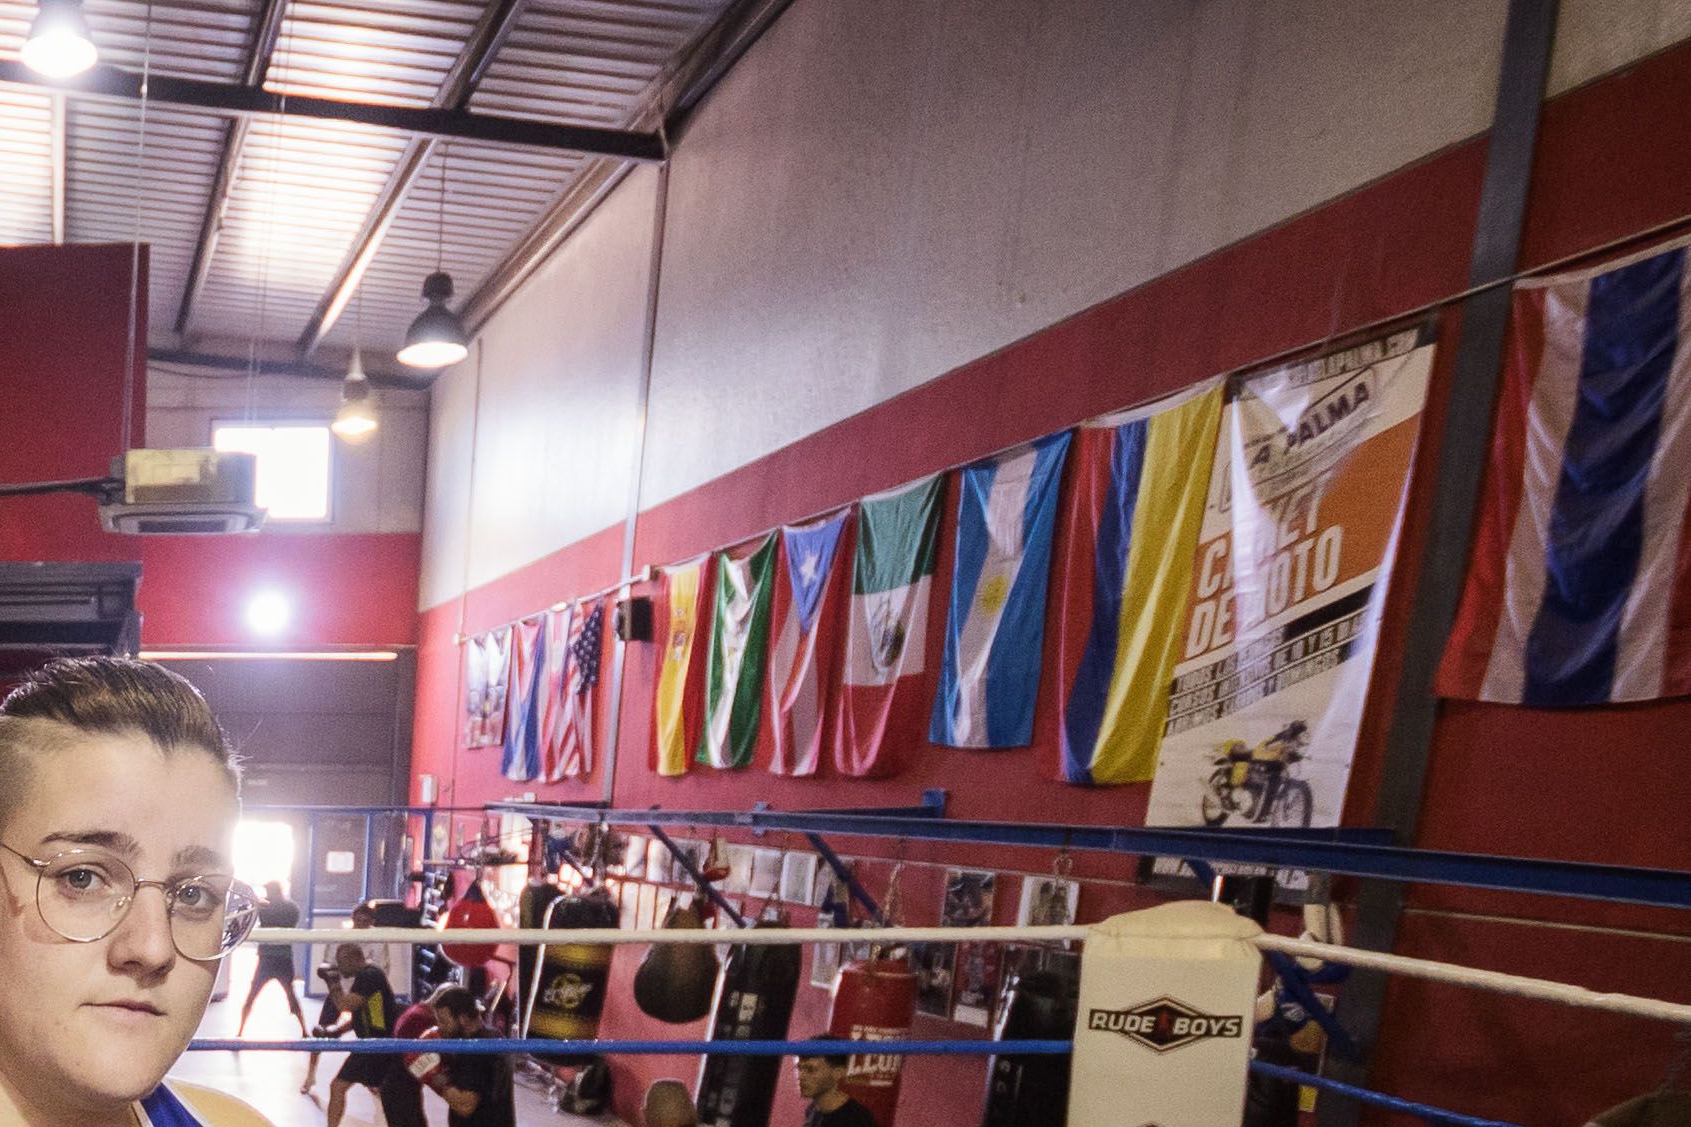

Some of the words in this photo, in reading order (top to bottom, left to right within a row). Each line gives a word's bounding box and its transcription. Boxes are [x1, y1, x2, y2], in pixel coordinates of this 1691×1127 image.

[1184, 592, 1236, 660] DE
[1090, 1012, 1156, 1033] RUDE
[1172, 1017, 1241, 1036] BOYS
